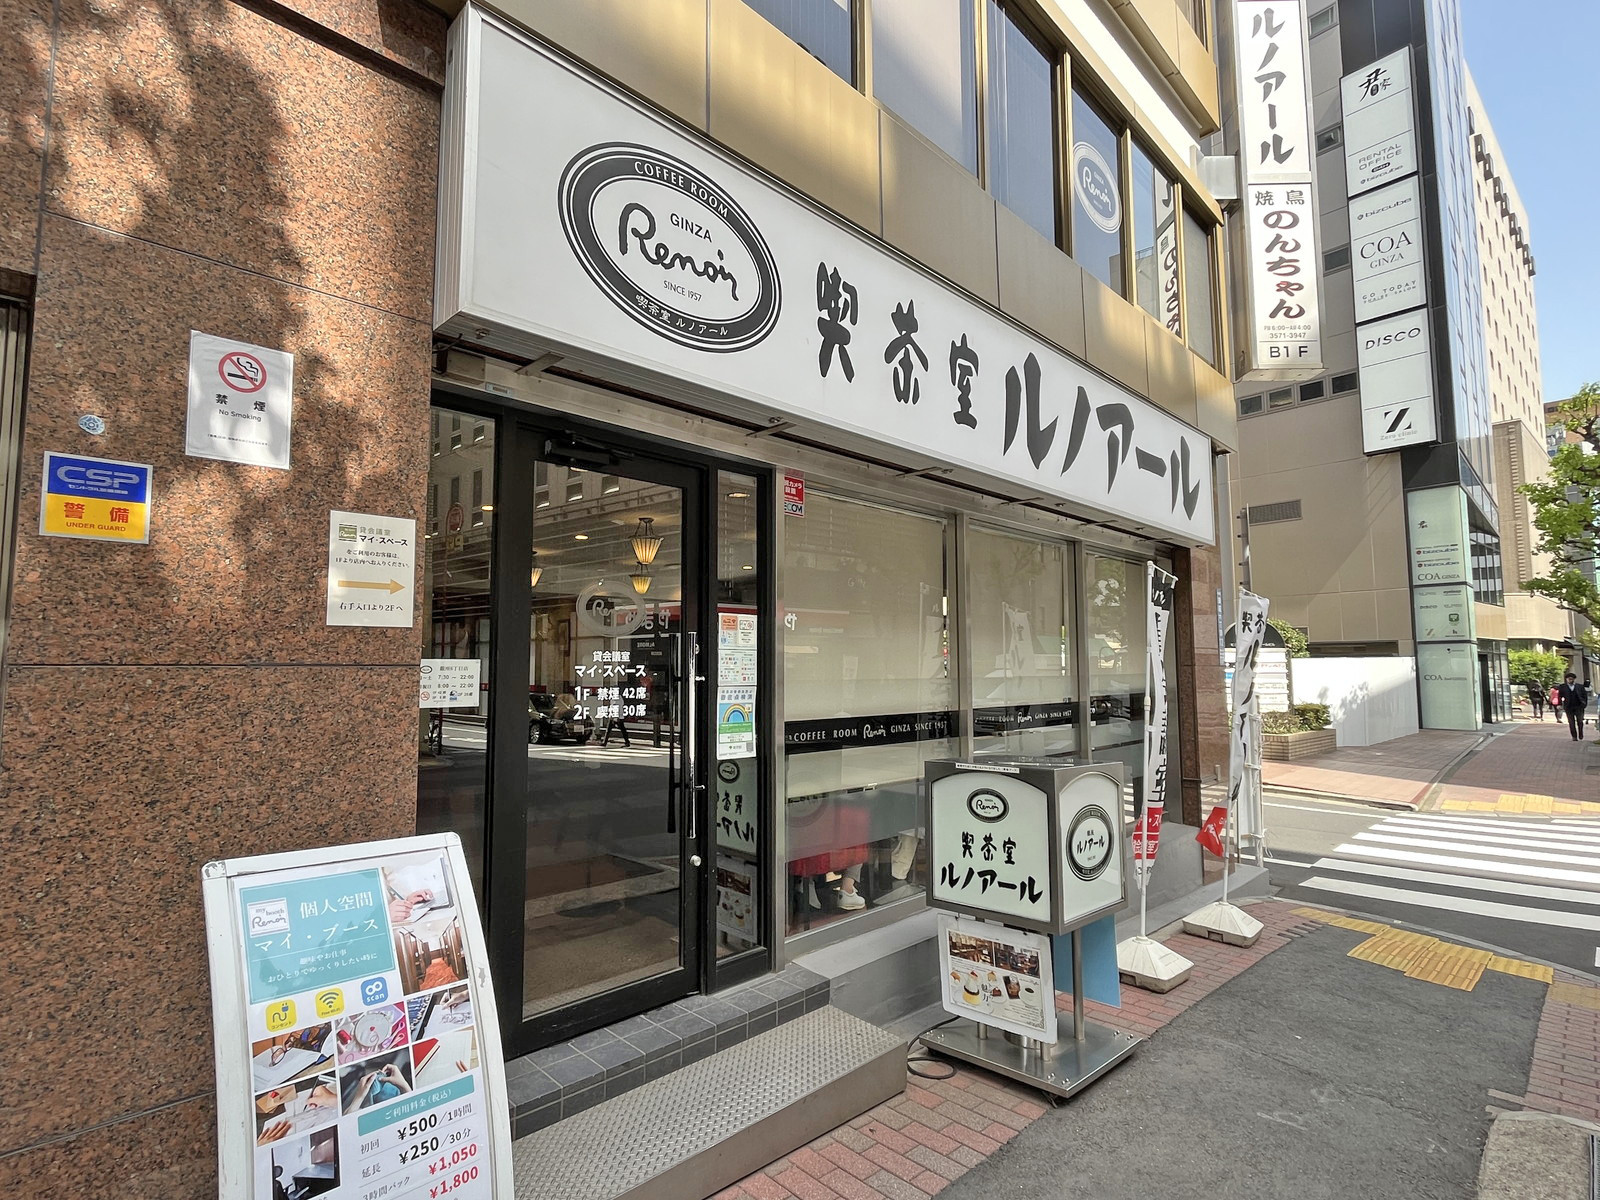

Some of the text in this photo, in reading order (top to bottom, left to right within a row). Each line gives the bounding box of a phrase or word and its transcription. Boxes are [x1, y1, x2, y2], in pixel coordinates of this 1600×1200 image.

[1251, 7, 1295, 165] ルノアール
[1358, 143, 1402, 164] RENTAL
[1358, 149, 1402, 171] OFFICE
[634, 161, 729, 218] COFFEE ROOM
[1254, 190, 1305, 206] 焼鳥
[670, 212, 713, 243] GINZA
[618, 202, 740, 301] Renoir
[1360, 231, 1412, 259] COA
[1262, 210, 1306, 319] のんちゃん
[1369, 252, 1404, 269] GINZA
[663, 279, 702, 302] SINCE 1957
[1361, 280, 1416, 300] GO TODAY
[636, 294, 730, 336] 喫茶室 ルノアール
[1365, 327, 1421, 350] DISCO
[817, 262, 979, 430] 喫茶室
[1003, 351, 1201, 521] ルノアール
[215, 393, 266, 413] 禁煙
[230, 410, 262, 423] Smoking
[57, 465, 140, 488] CSP
[63, 502, 130, 524] 警備
[66, 521, 127, 532] UNDER GUARD
[359, 535, 409, 547] マイ・スペース
[1417, 573, 1441, 581] COA
[592, 651, 631, 662] 貸会議室
[574, 664, 647, 678] マイ・スペース
[574, 686, 647, 701] 1F 禁煙 42席
[573, 703, 647, 720] 2F 喫煙 30席
[793, 730, 826, 742] COFFEE
[833, 728, 857, 738] ROOM
[890, 724, 911, 733] GINZA
[914, 721, 932, 731] SINCE
[934, 721, 947, 729] 1957
[961, 831, 1017, 865] 喫茶室
[1076, 835, 1105, 855] ルノアール
[940, 862, 1044, 904] ルノアール
[299, 891, 374, 919] 個人空間
[254, 918, 379, 953] マイ・ブース
[267, 952, 378, 983] おひとりでゆっくりしたい時に
[366, 993, 385, 1003] scan
[270, 1021, 292, 1030] コンセント
[361, 1138, 380, 1154] 初回
[428, 1142, 478, 1176] ¥1,050
[362, 1163, 382, 1179] 延長
[429, 1165, 479, 1200] ¥1,800
